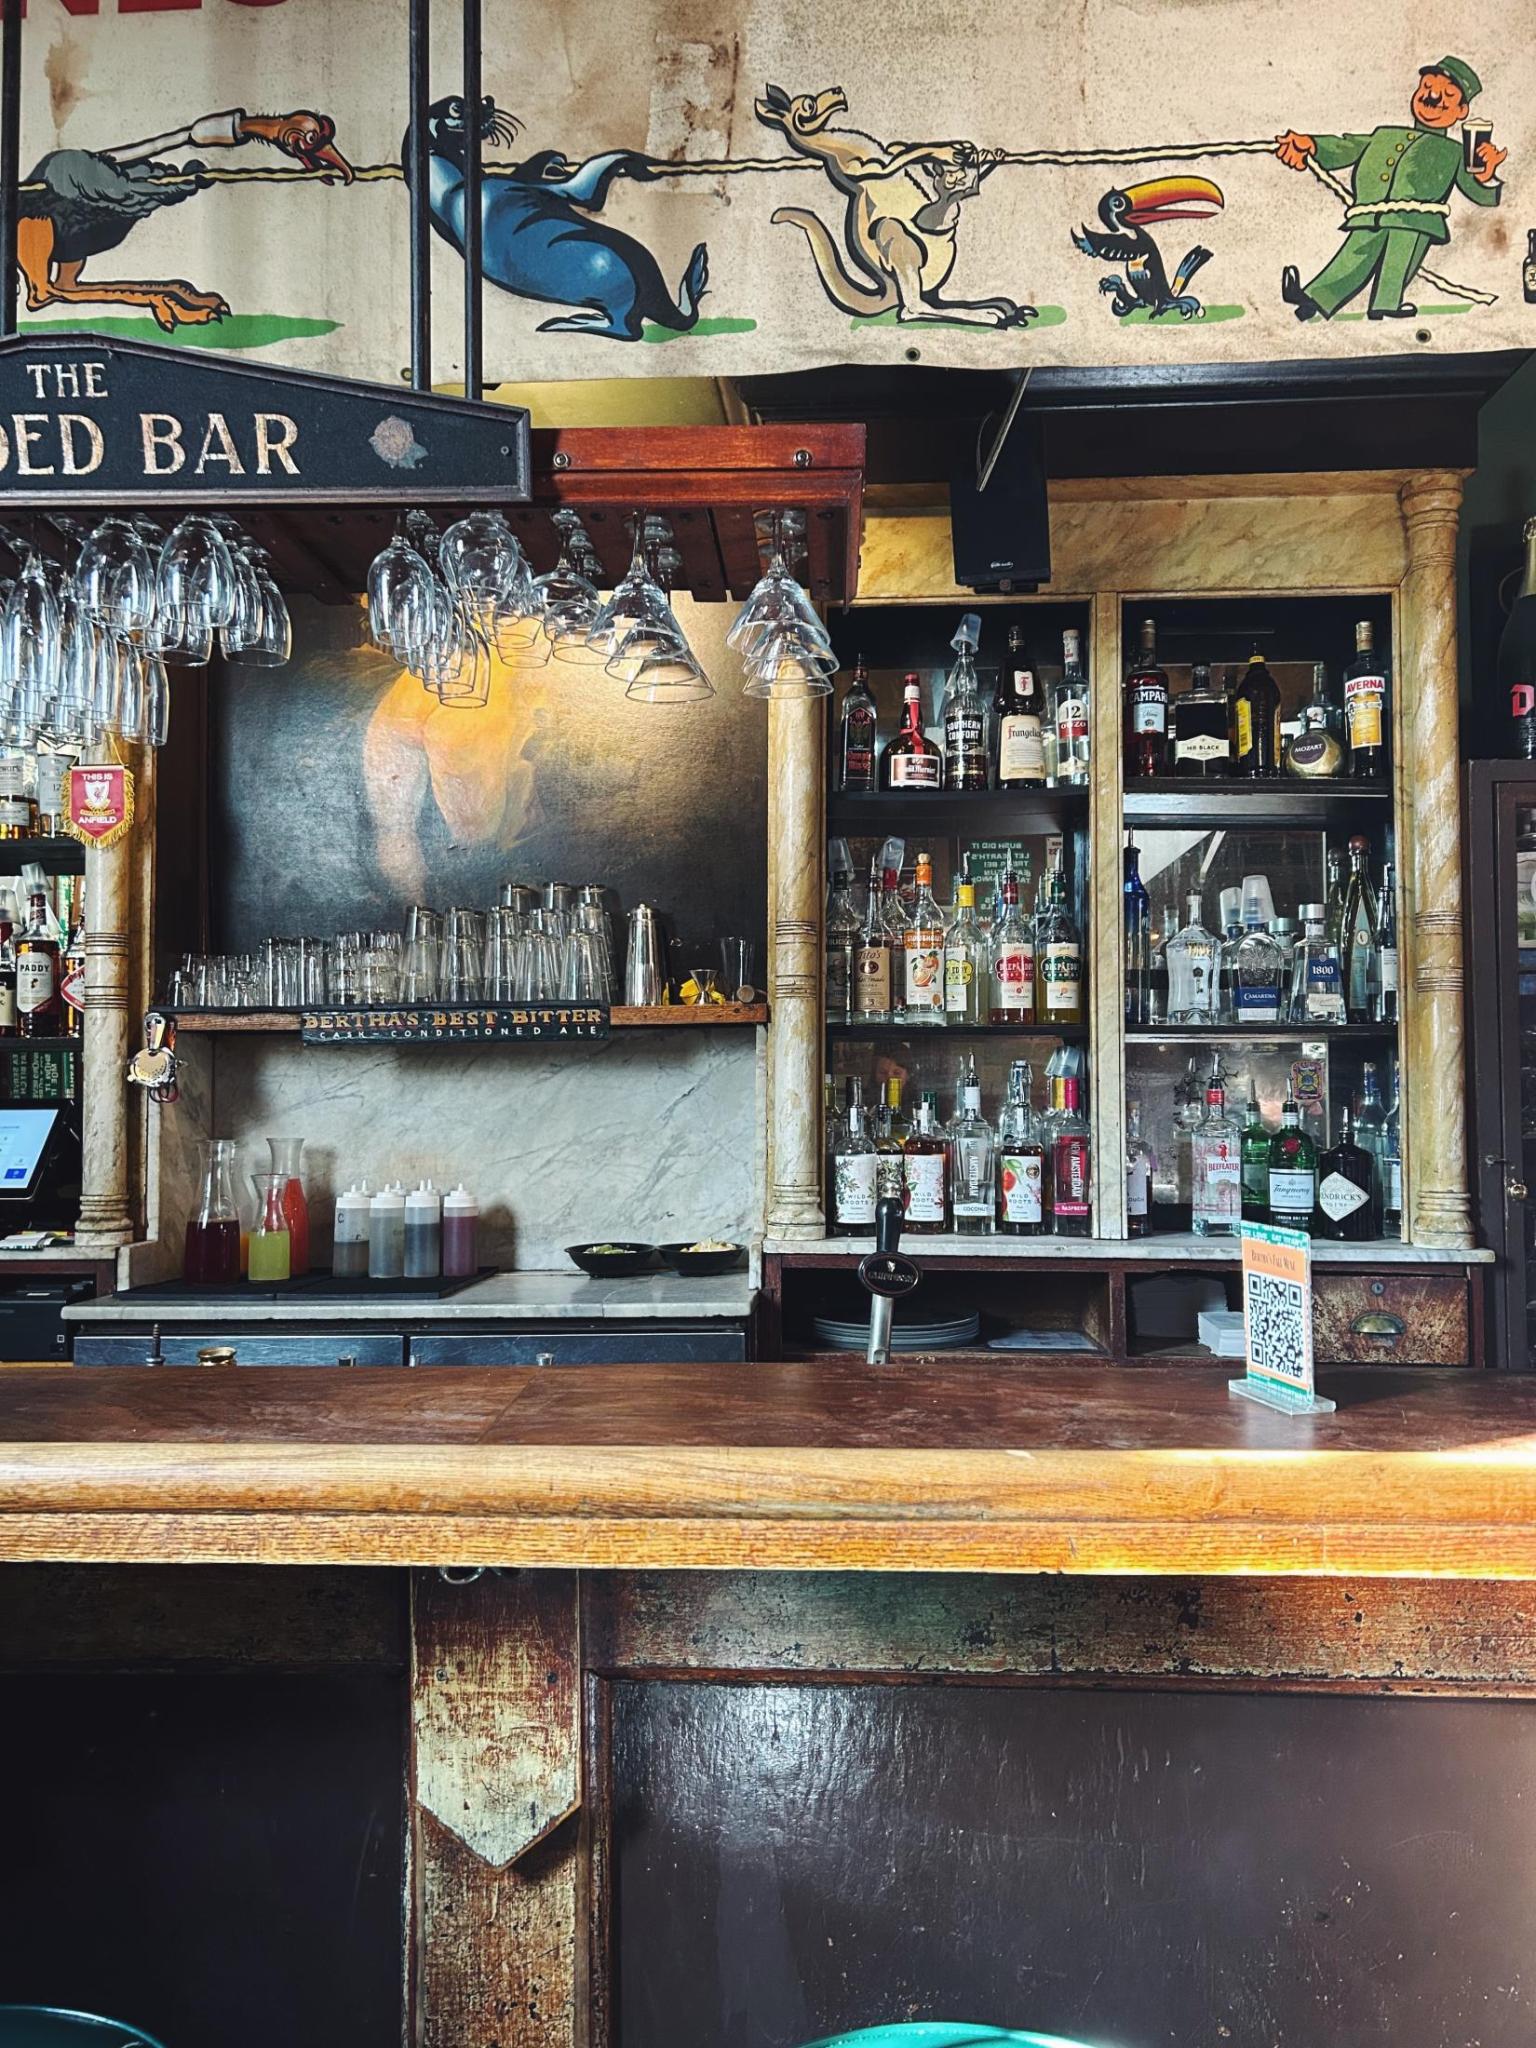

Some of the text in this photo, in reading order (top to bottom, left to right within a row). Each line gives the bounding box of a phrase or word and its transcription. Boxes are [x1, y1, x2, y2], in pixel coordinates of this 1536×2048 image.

[26, 362, 109, 398] THE
[0, 412, 301, 475] ED BAR
[1346, 679, 1384, 694] AVERNA
[1065, 705, 1082, 719] 12
[946, 719, 981, 733] SOUTHERN
[1008, 725, 1041, 739] Frangelic
[1294, 743, 1324, 753] MOZART
[82, 773, 103, 781] THIS
[78, 816, 118, 824] ANFIELD
[858, 949, 882, 959] Tito's
[20, 964, 50, 972] PADDY
[1312, 965, 1334, 975] 1800
[303, 1008, 602, 1029] BERTHA'S BEST BITTER
[559, 1025, 598, 1034] ALE
[1208, 1163, 1240, 1172] BEEFEATER
[969, 1155, 979, 1197] AMSTERDAM
[1071, 1155, 1081, 1198] AMSTERDAM
[1273, 1184, 1311, 1195] Tanqueray
[1319, 1193, 1362, 1201] ENDRICK'S
